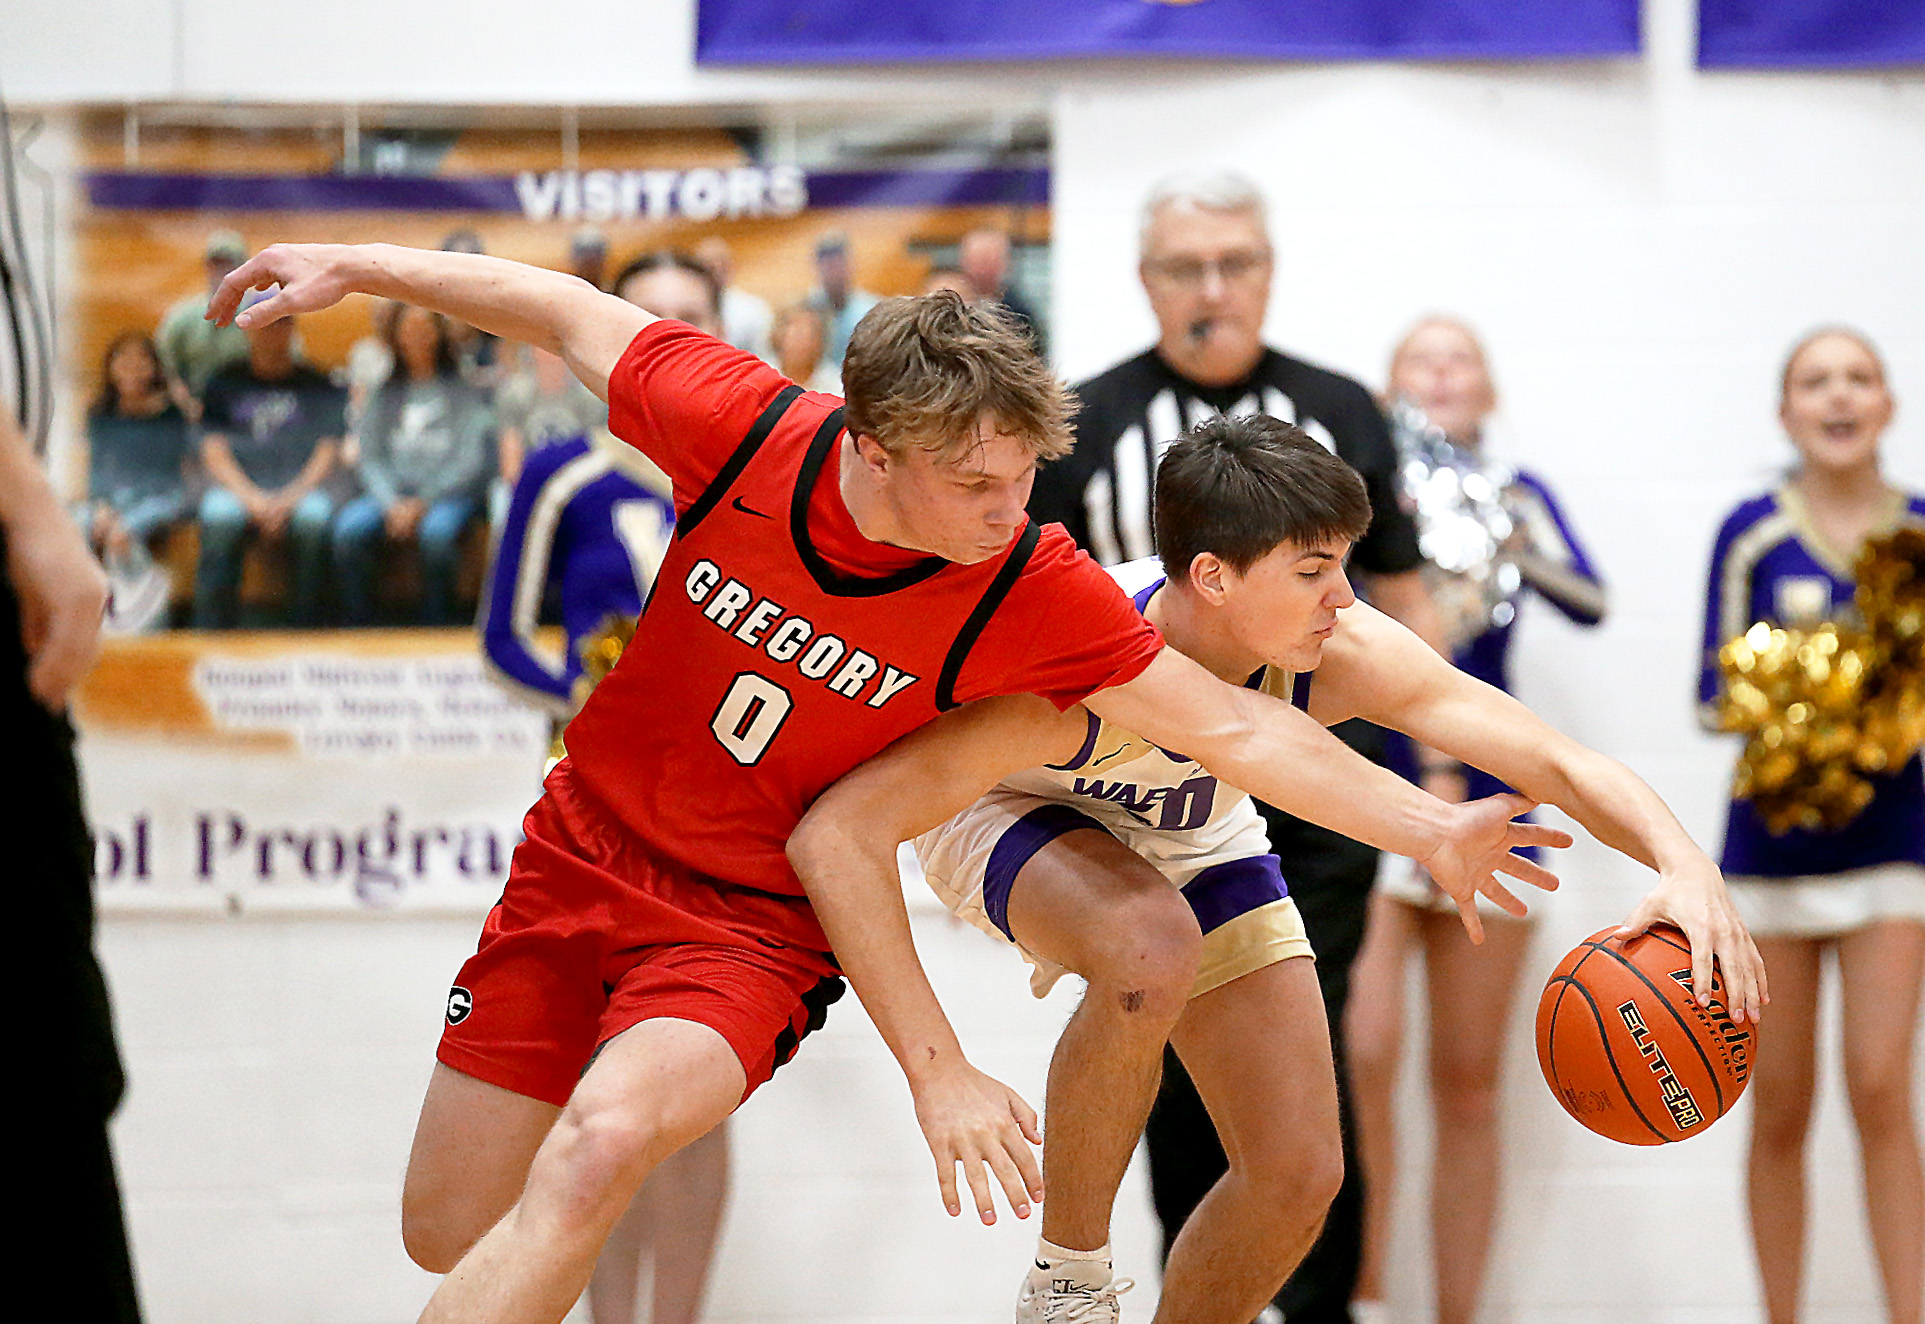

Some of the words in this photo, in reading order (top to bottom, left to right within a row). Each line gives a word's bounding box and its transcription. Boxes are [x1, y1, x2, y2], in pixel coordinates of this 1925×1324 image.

[517, 166, 807, 220] VISITORS
[686, 558, 921, 709] GREGORY
[709, 670, 795, 767] 0
[195, 806, 512, 906] Progra
[1616, 999, 1684, 1100] ELITE
[1665, 1091, 1703, 1130] PRO
